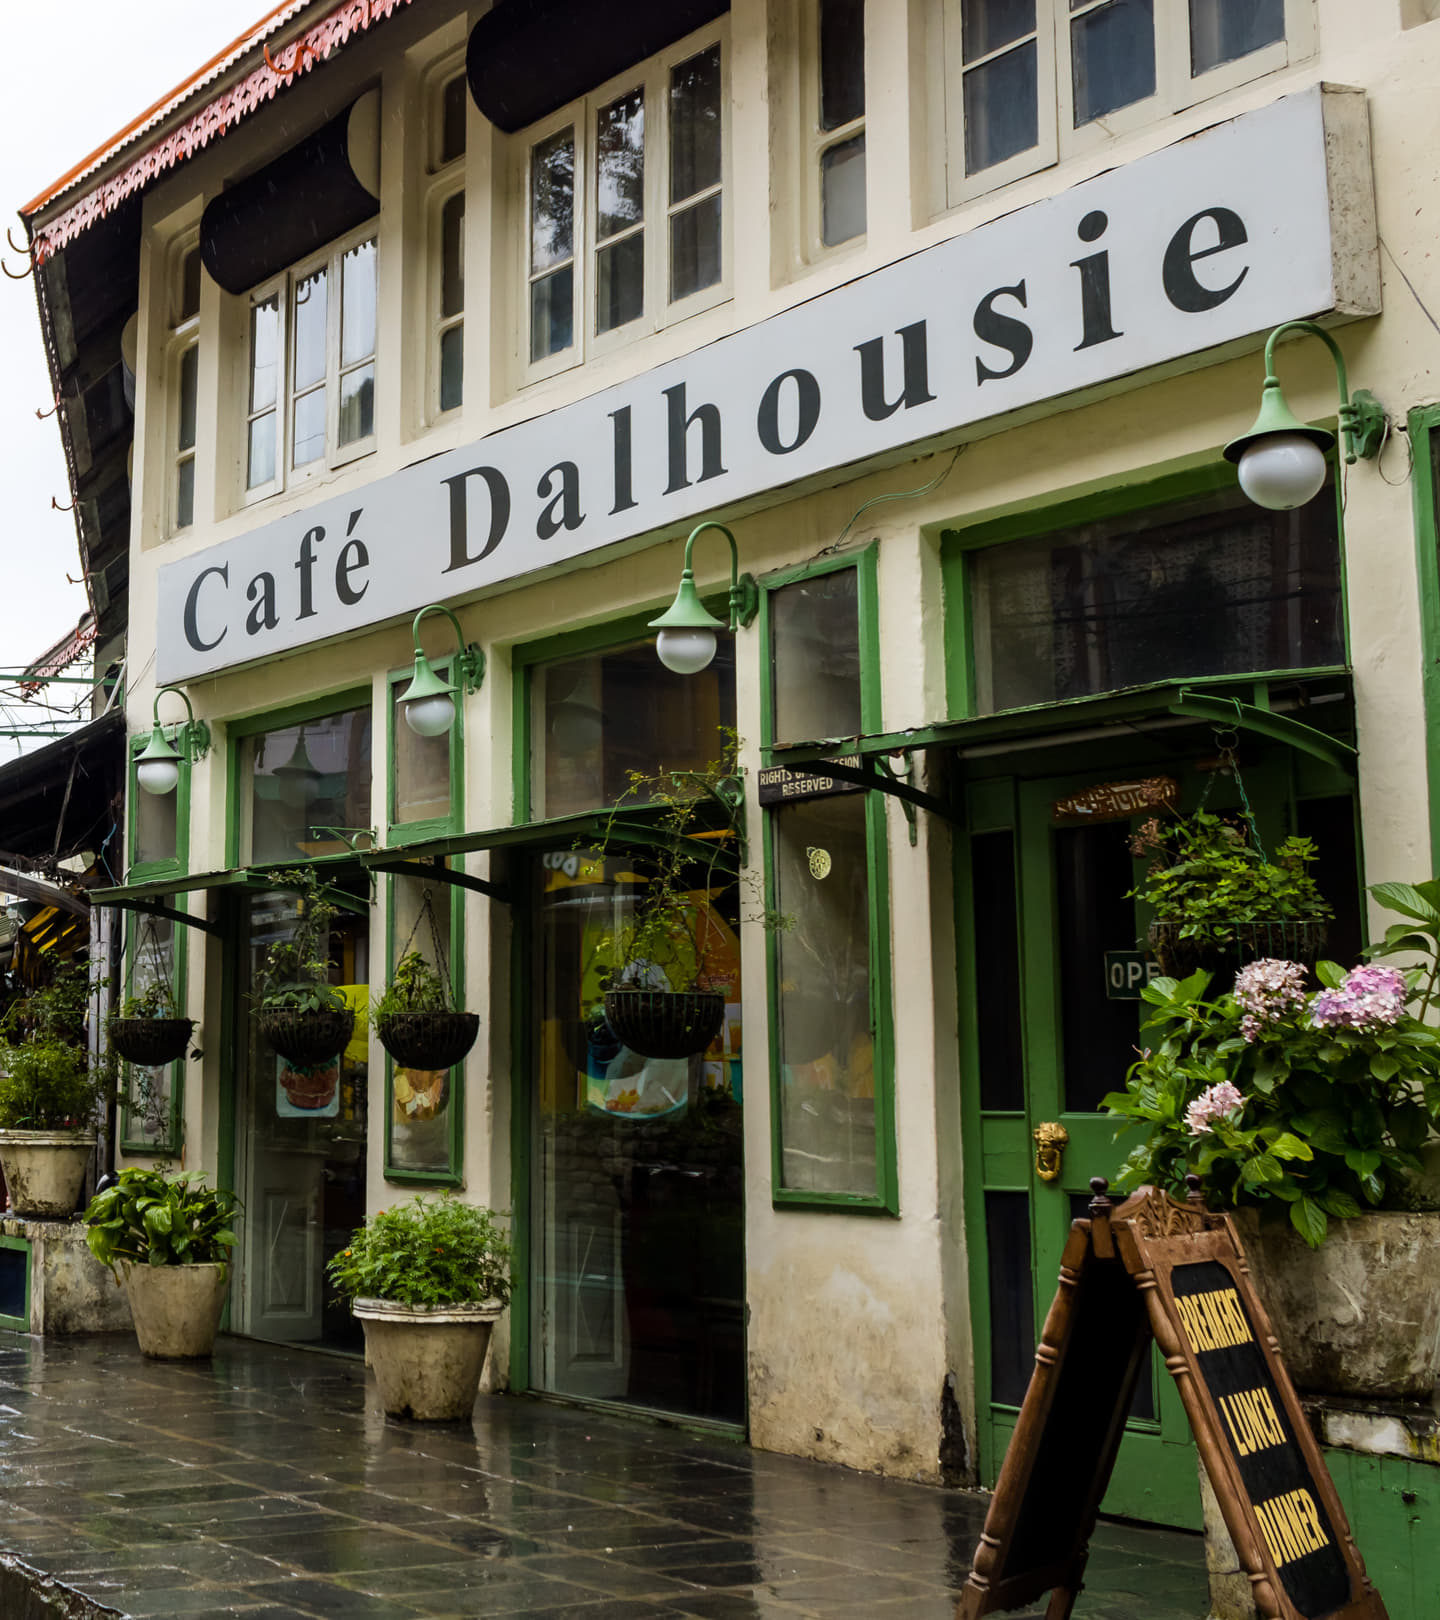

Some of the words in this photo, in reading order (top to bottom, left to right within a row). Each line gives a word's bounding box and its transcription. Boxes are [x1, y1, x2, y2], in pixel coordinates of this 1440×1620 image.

[183, 511, 371, 652] Café
[440, 205, 1251, 576] Dalhousie
[759, 768, 792, 786] RIGHTS
[782, 777, 833, 797] RESERVED
[1173, 1287, 1254, 1354] BREAKFAST
[1218, 1386, 1287, 1457] LUNCH
[1253, 1486, 1330, 1569] DINNER
